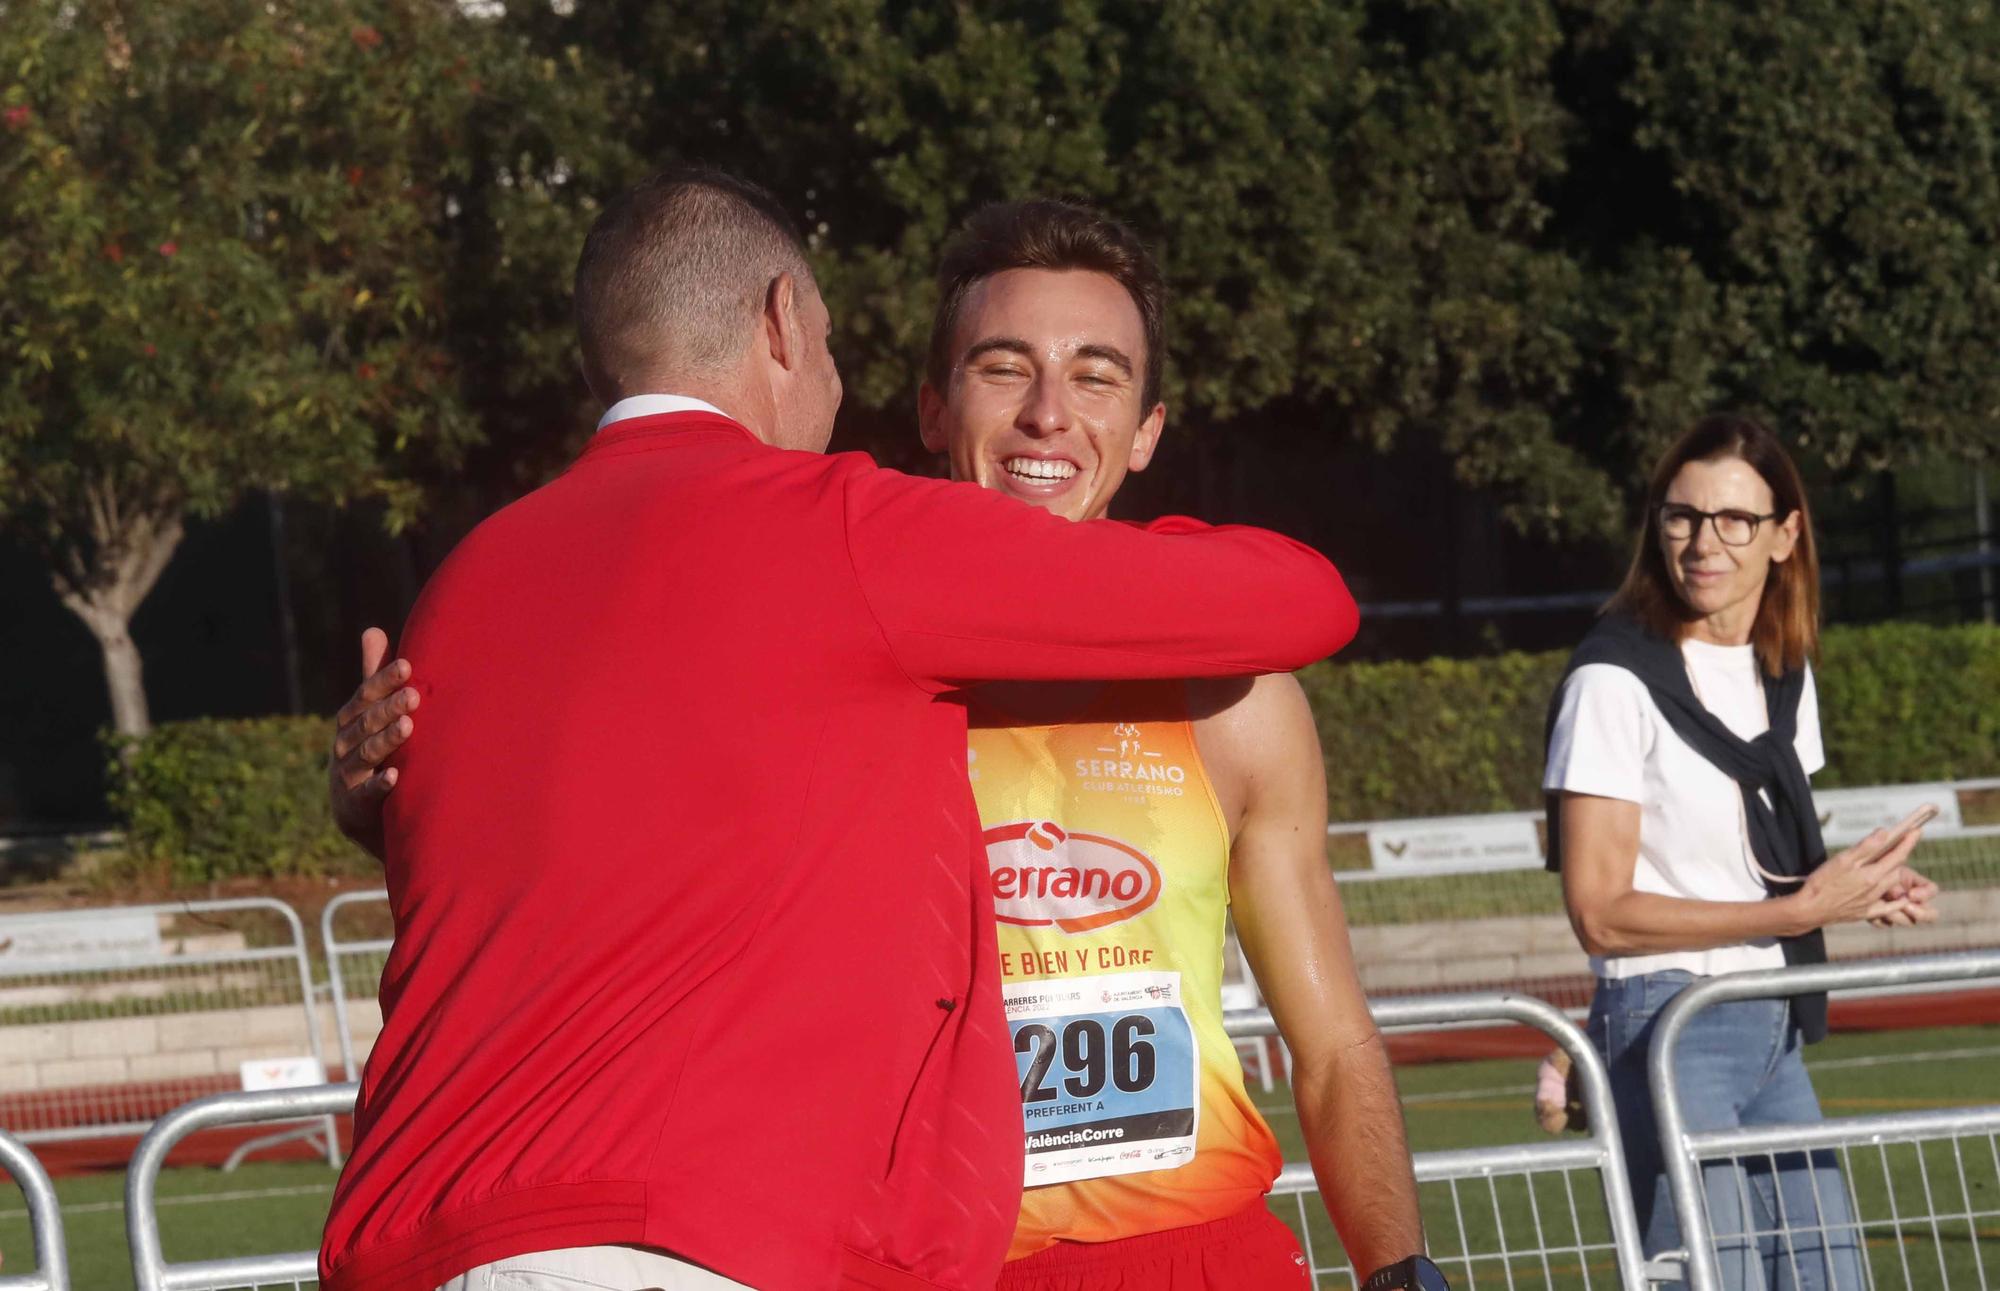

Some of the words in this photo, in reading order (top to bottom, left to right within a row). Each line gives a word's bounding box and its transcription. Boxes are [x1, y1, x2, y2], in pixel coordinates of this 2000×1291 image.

[1076, 759, 1185, 784] SERRANO
[1083, 781, 1114, 792] CLUB
[1118, 783, 1183, 796] ATLETISMO
[991, 866, 1142, 901] errano
[1021, 950, 1069, 976] BIEN
[1076, 949, 1089, 971] Y
[1003, 996, 1038, 1007] ARRERES
[1014, 1015, 1156, 1103] 296
[1026, 1101, 1093, 1119] PREFERENT
[1096, 1101, 1104, 1111] A
